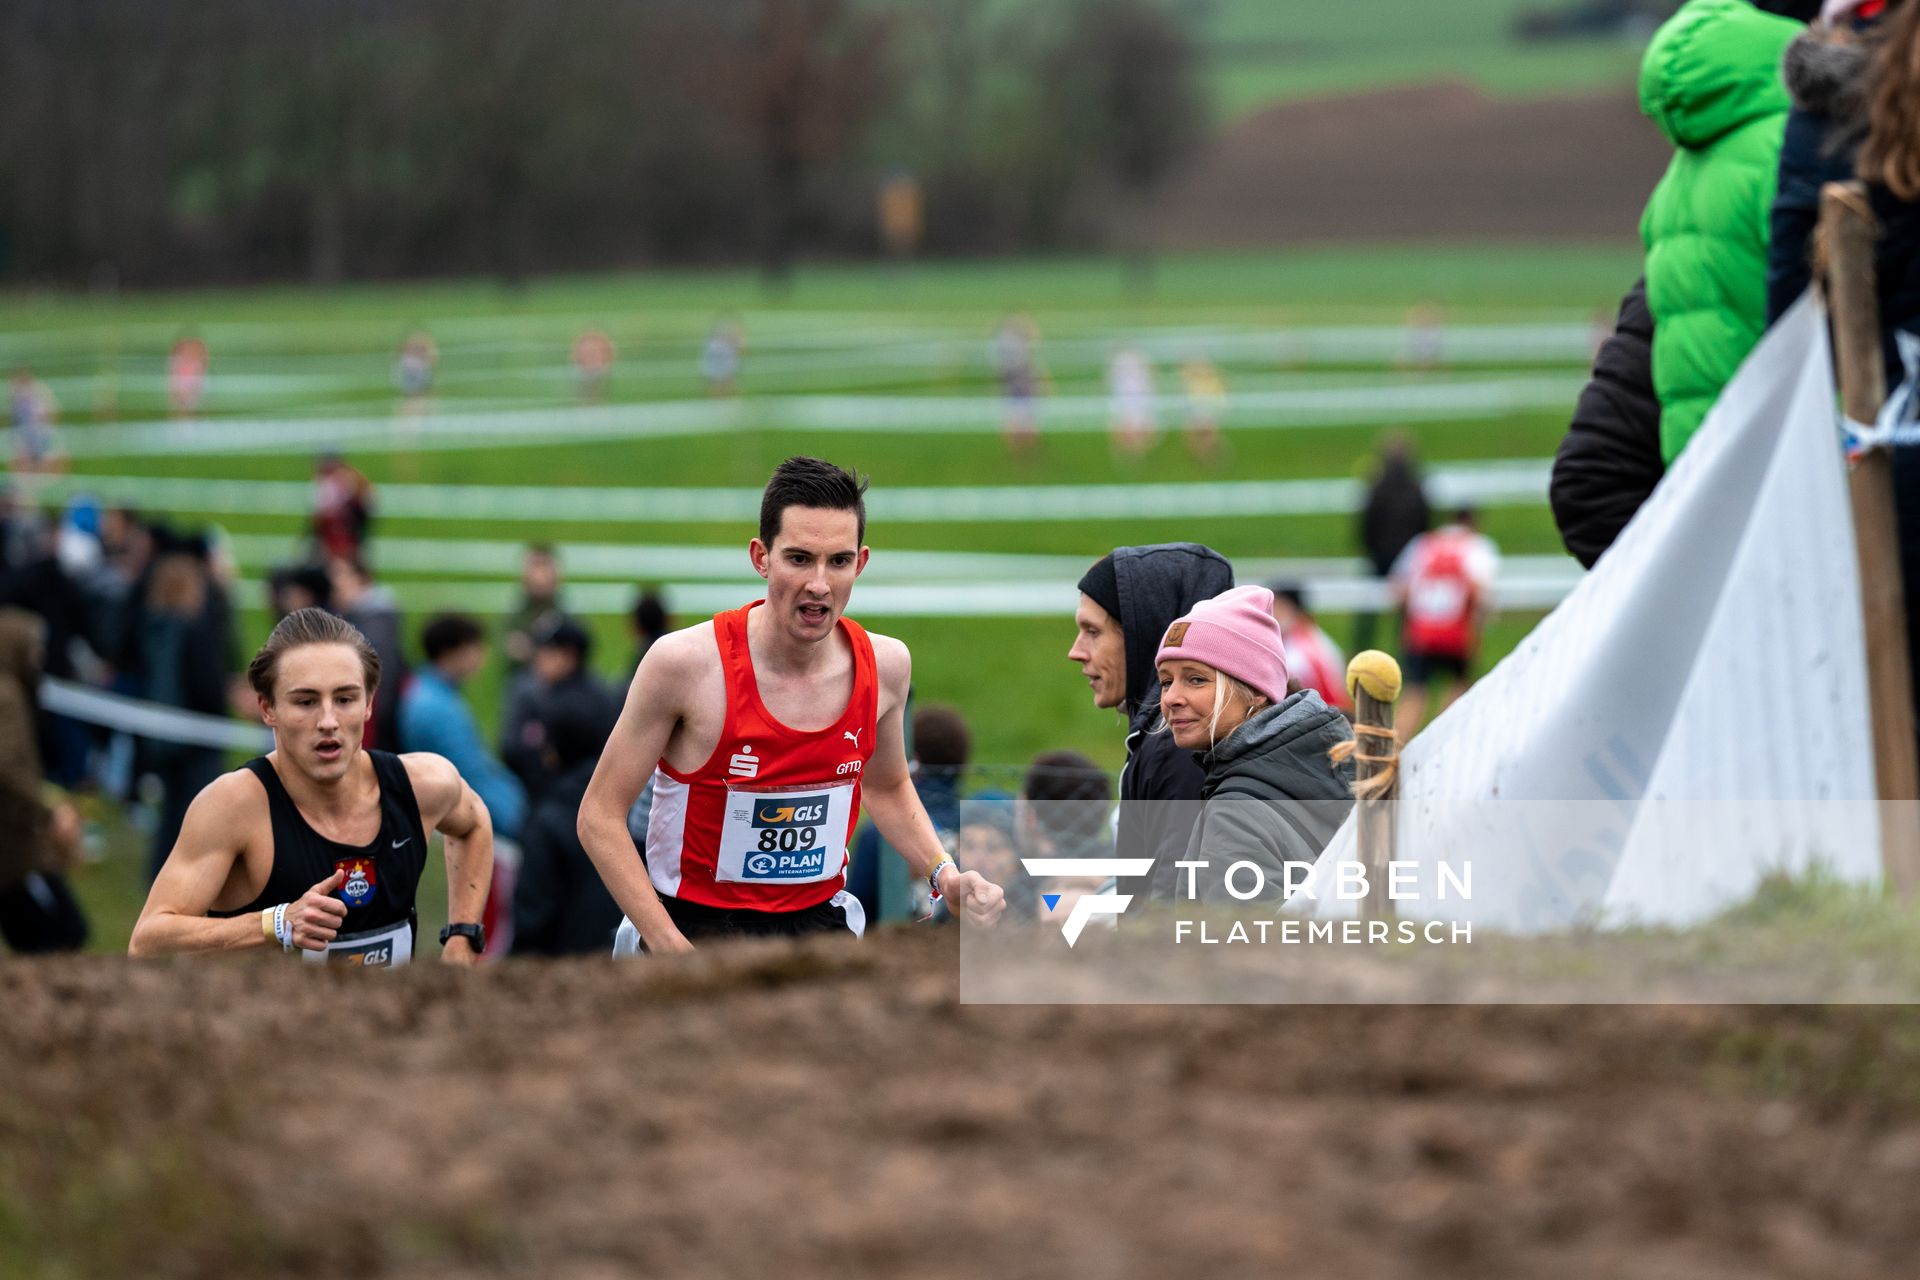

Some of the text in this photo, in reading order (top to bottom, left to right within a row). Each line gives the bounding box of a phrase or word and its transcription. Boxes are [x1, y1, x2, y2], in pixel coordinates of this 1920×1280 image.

[794, 804, 823, 821] GLS
[758, 827, 816, 852] 809
[779, 853, 822, 868] PLAN
[364, 947, 388, 965] GLS
